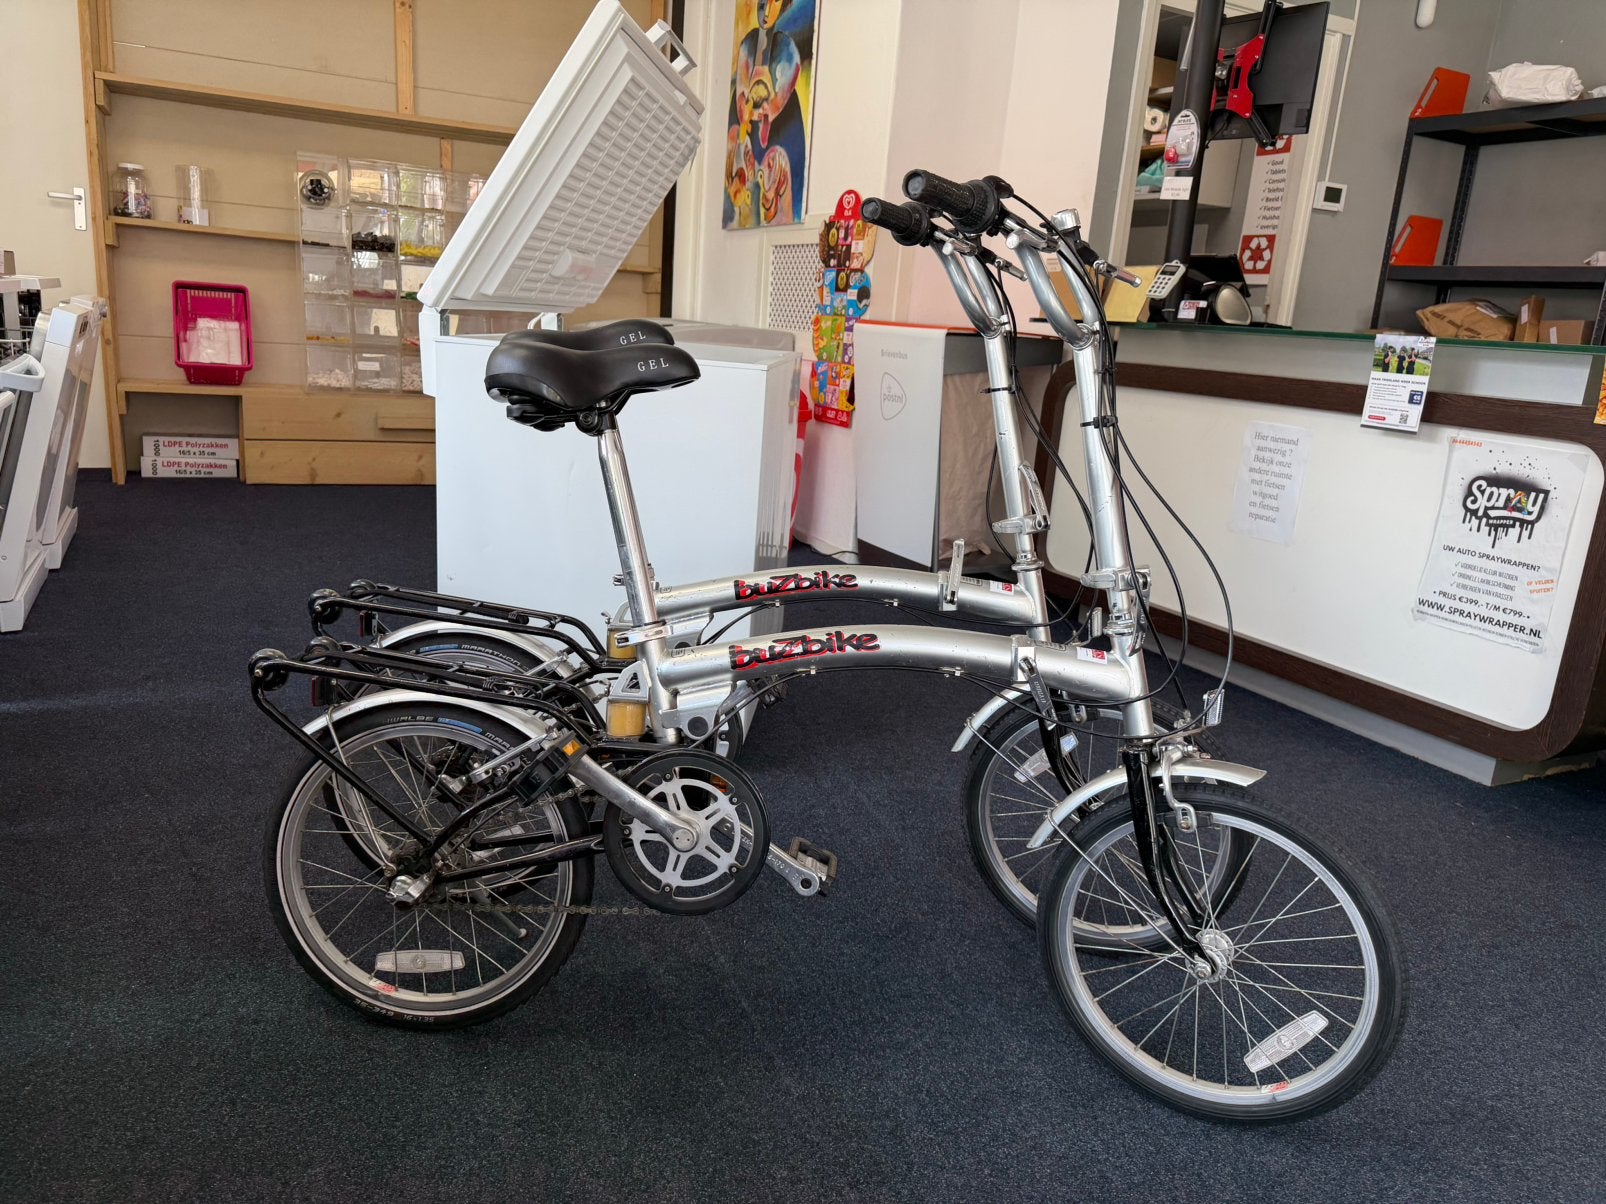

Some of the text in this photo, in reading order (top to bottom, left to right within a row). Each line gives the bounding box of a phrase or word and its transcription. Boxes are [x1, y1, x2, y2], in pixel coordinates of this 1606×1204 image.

[620, 331, 646, 345] GEL
[637, 358, 669, 371] GEL
[186, 441, 229, 449] Polyzakken
[1254, 432, 1299, 446] Hier niemand
[1256, 446, 1287, 457] aanwezig
[185, 461, 228, 470] Polyzakken
[1253, 455, 1274, 467] Bekijk
[1248, 466, 1293, 480] andere ruimte
[1250, 478, 1286, 490] met fietsen
[1253, 490, 1279, 501] witgoed
[1466, 479, 1545, 521] Spray
[1258, 501, 1280, 512] fietsen
[1248, 512, 1277, 524] reparatie
[1442, 543, 1541, 572] UW AUTO SPRAYWRAPPEN?
[1438, 590, 1457, 601] PRIJS
[1485, 602, 1501, 612] T/M
[1418, 597, 1543, 639] WWW.SPRAYWRAPPER.NL
